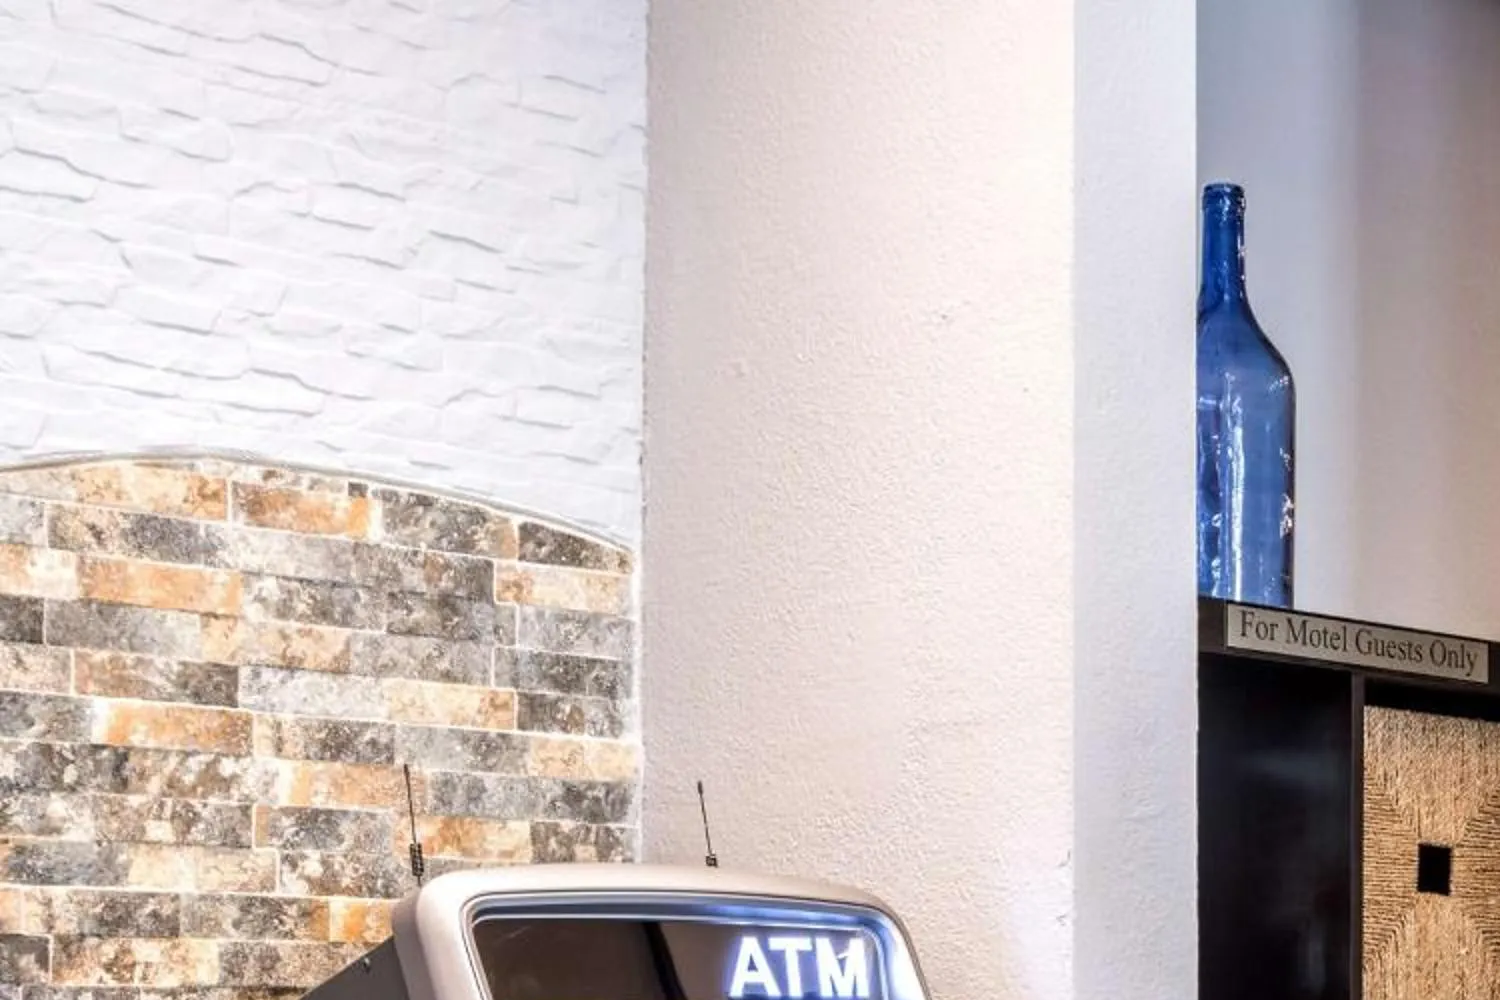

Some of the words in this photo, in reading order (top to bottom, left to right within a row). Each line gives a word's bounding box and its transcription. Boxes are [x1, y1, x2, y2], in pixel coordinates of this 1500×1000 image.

[1239, 610, 1279, 641] For
[1285, 617, 1348, 652] Motel
[1355, 628, 1423, 664] Guests
[1429, 639, 1479, 676] Only
[728, 935, 870, 998] ATM
